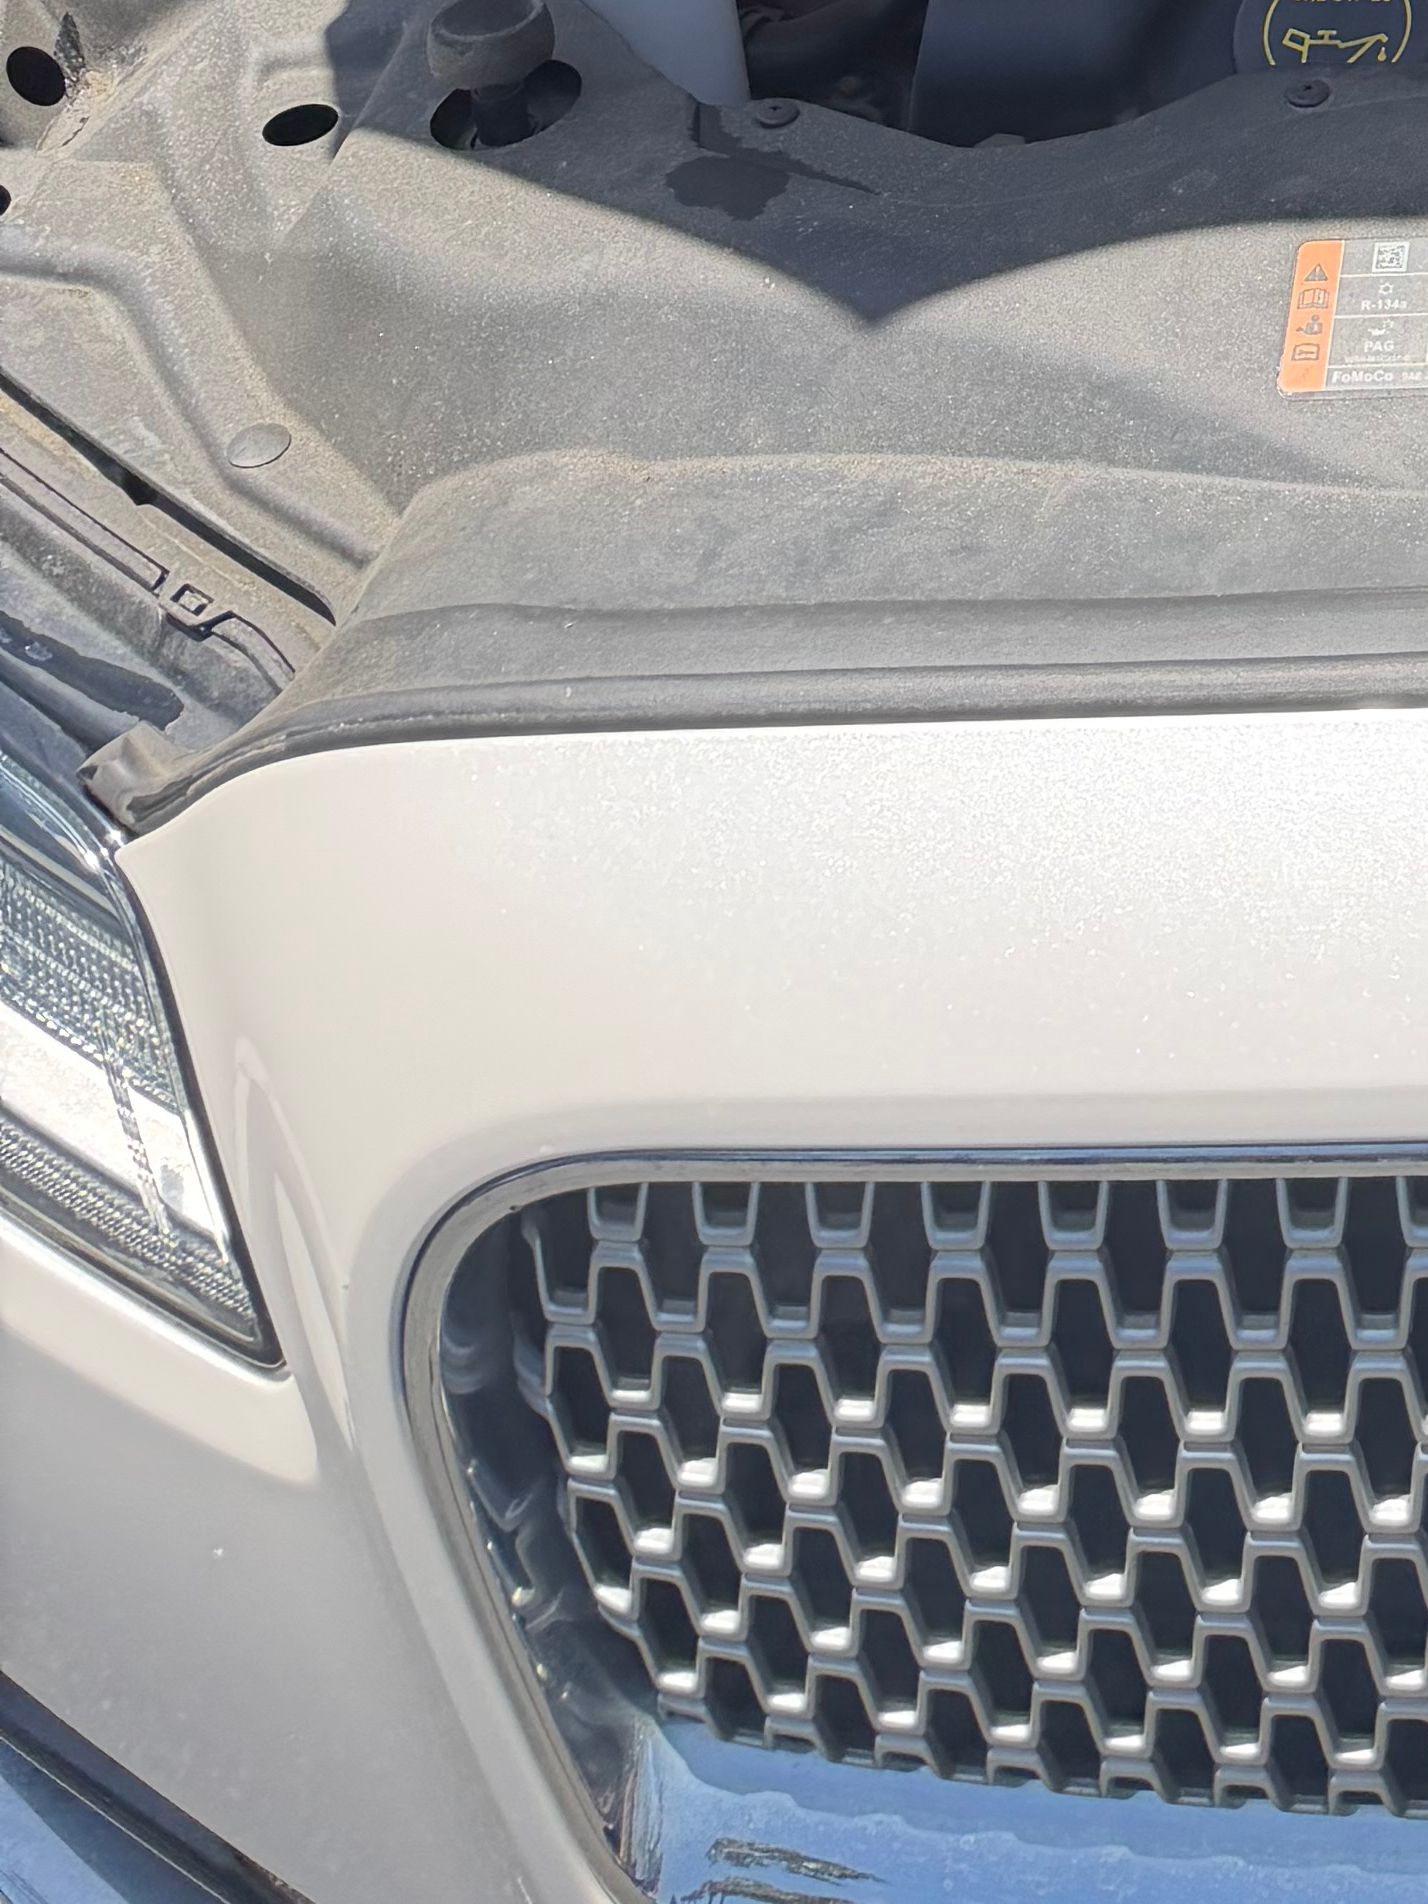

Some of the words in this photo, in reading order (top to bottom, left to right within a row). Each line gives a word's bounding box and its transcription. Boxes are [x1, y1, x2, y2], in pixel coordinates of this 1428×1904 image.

[1360, 299, 1408, 311] R-134a
[1363, 340, 1395, 353] PAG
[1331, 369, 1394, 384] FoMoCo
